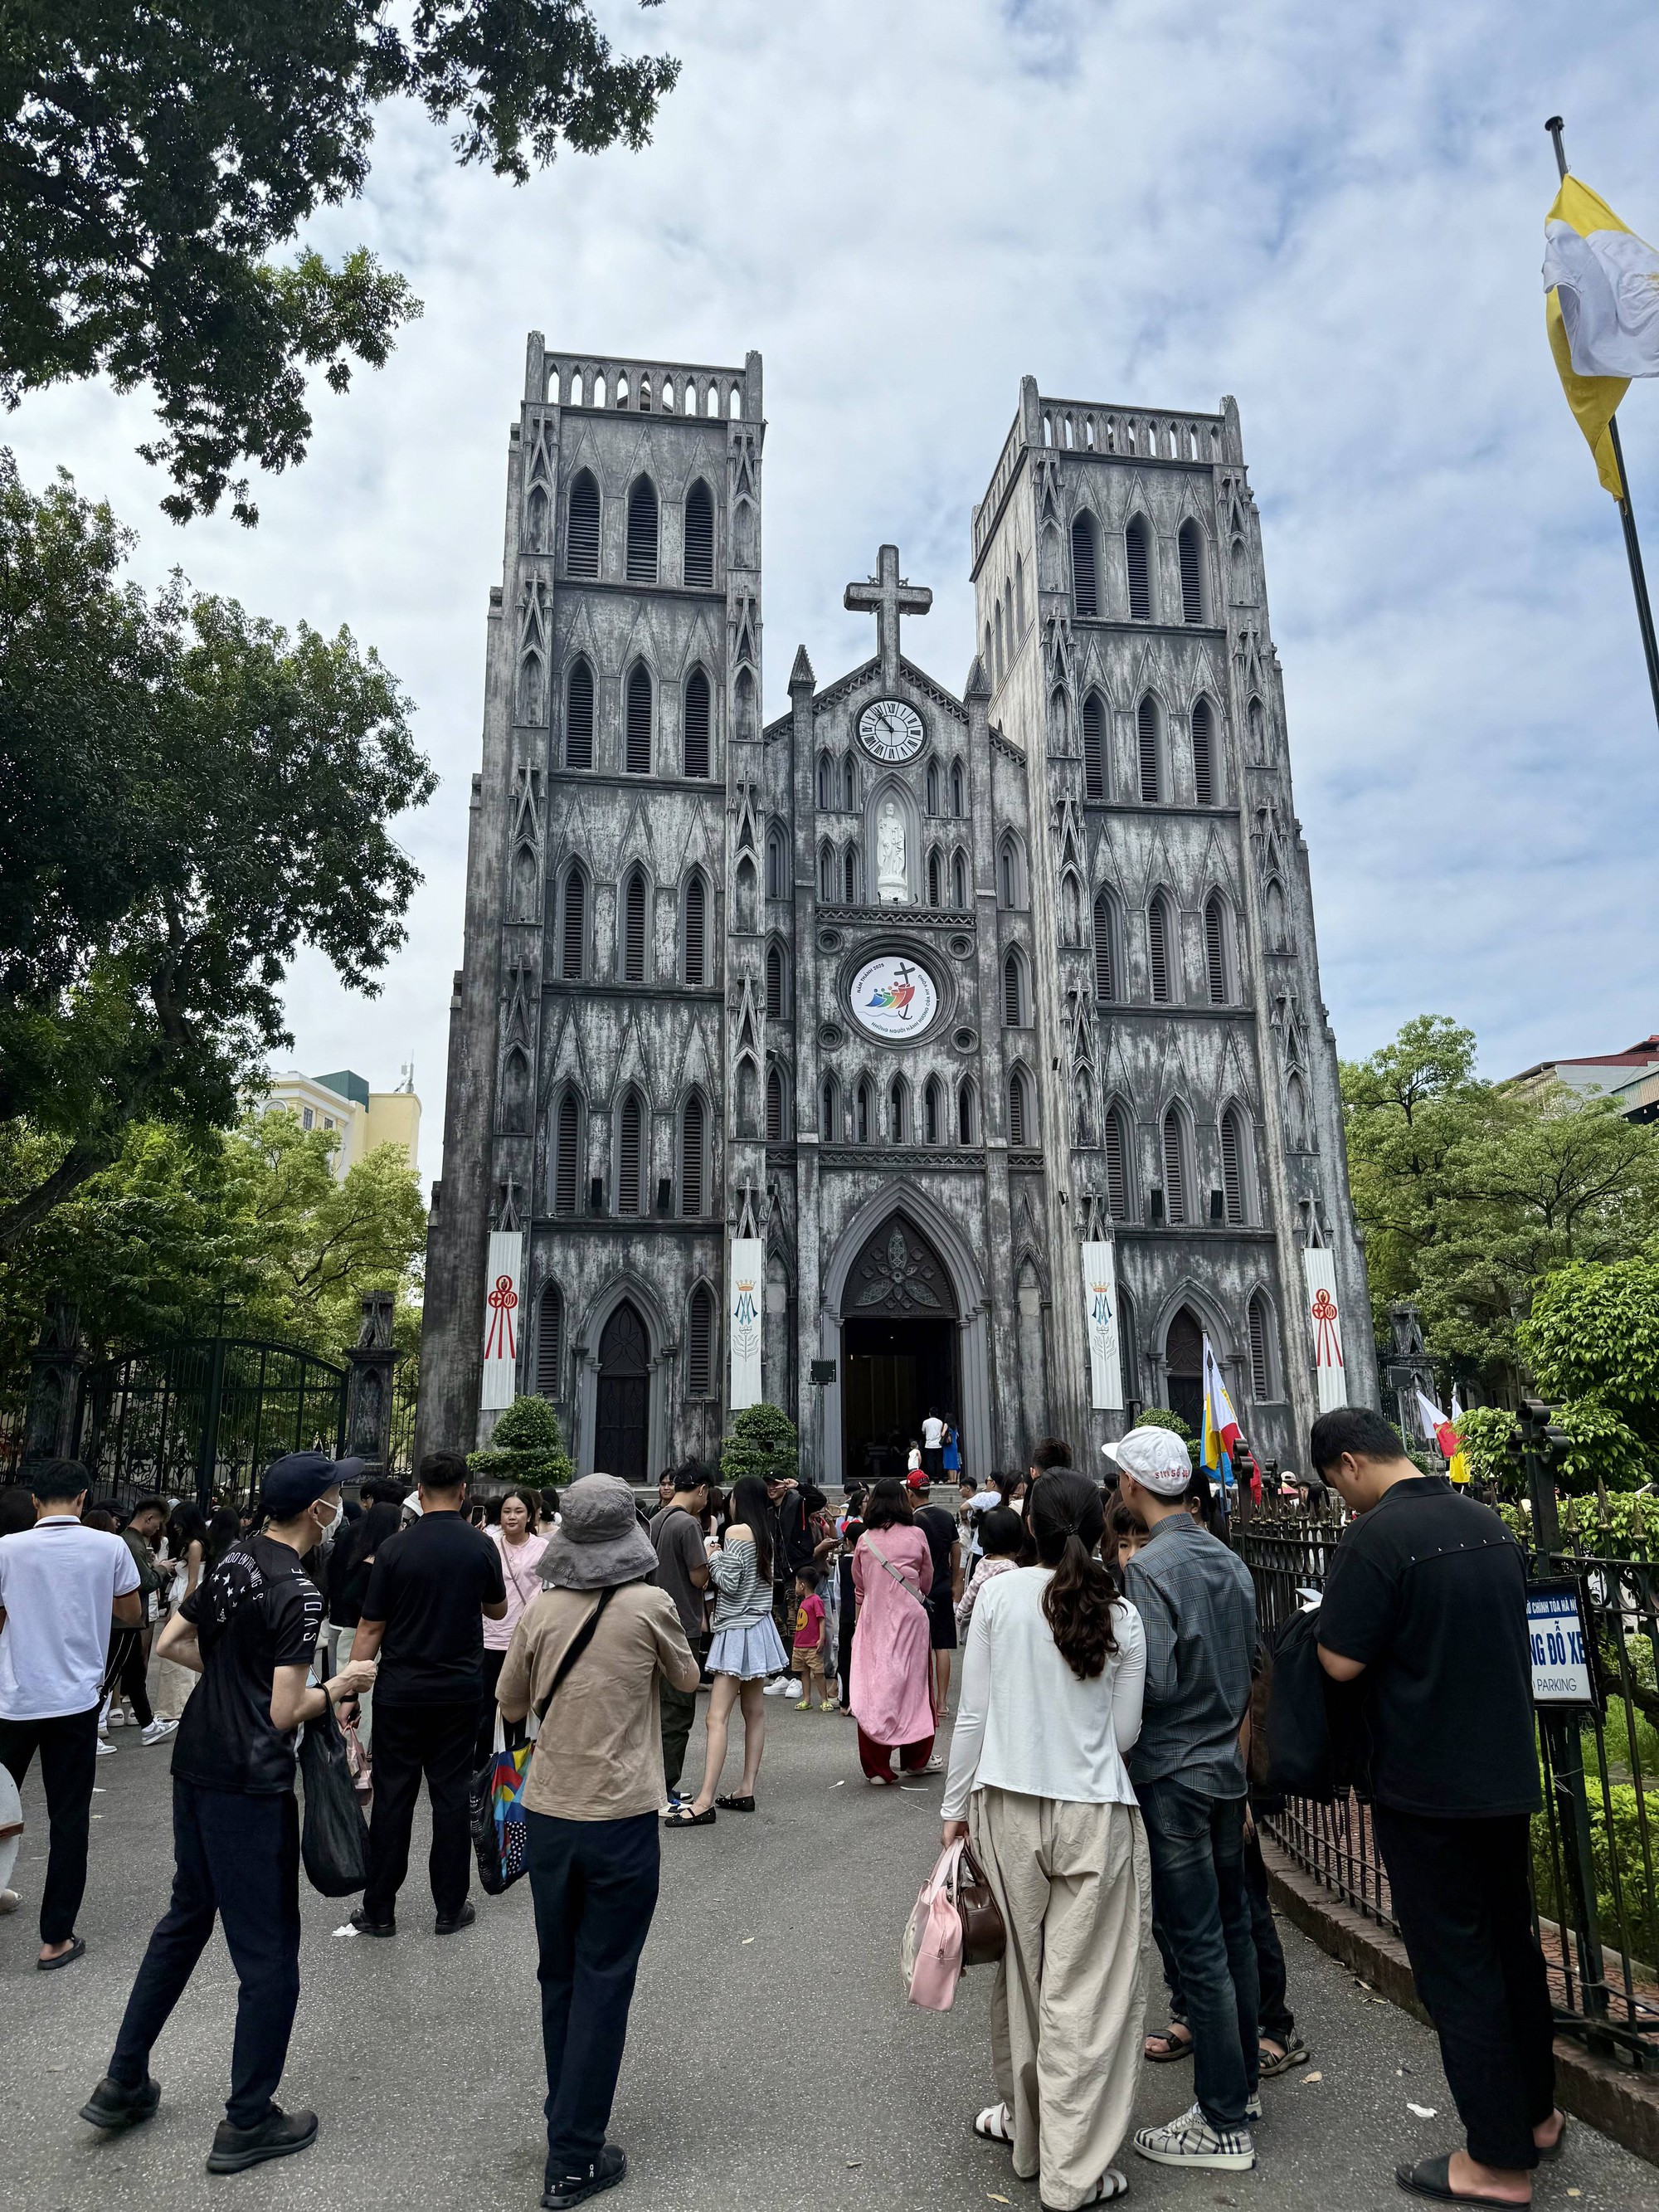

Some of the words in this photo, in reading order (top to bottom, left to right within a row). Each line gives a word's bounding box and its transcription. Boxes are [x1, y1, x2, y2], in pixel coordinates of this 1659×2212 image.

[1532, 1600, 1550, 1614] CHÍNH
[1549, 1598, 1561, 1613] TÒA
[1561, 1596, 1569, 1612] HÀ
[1546, 1620, 1566, 1665] ĐỖ
[1567, 1630, 1586, 1664] XE
[1537, 1678, 1577, 1692] PARKING
